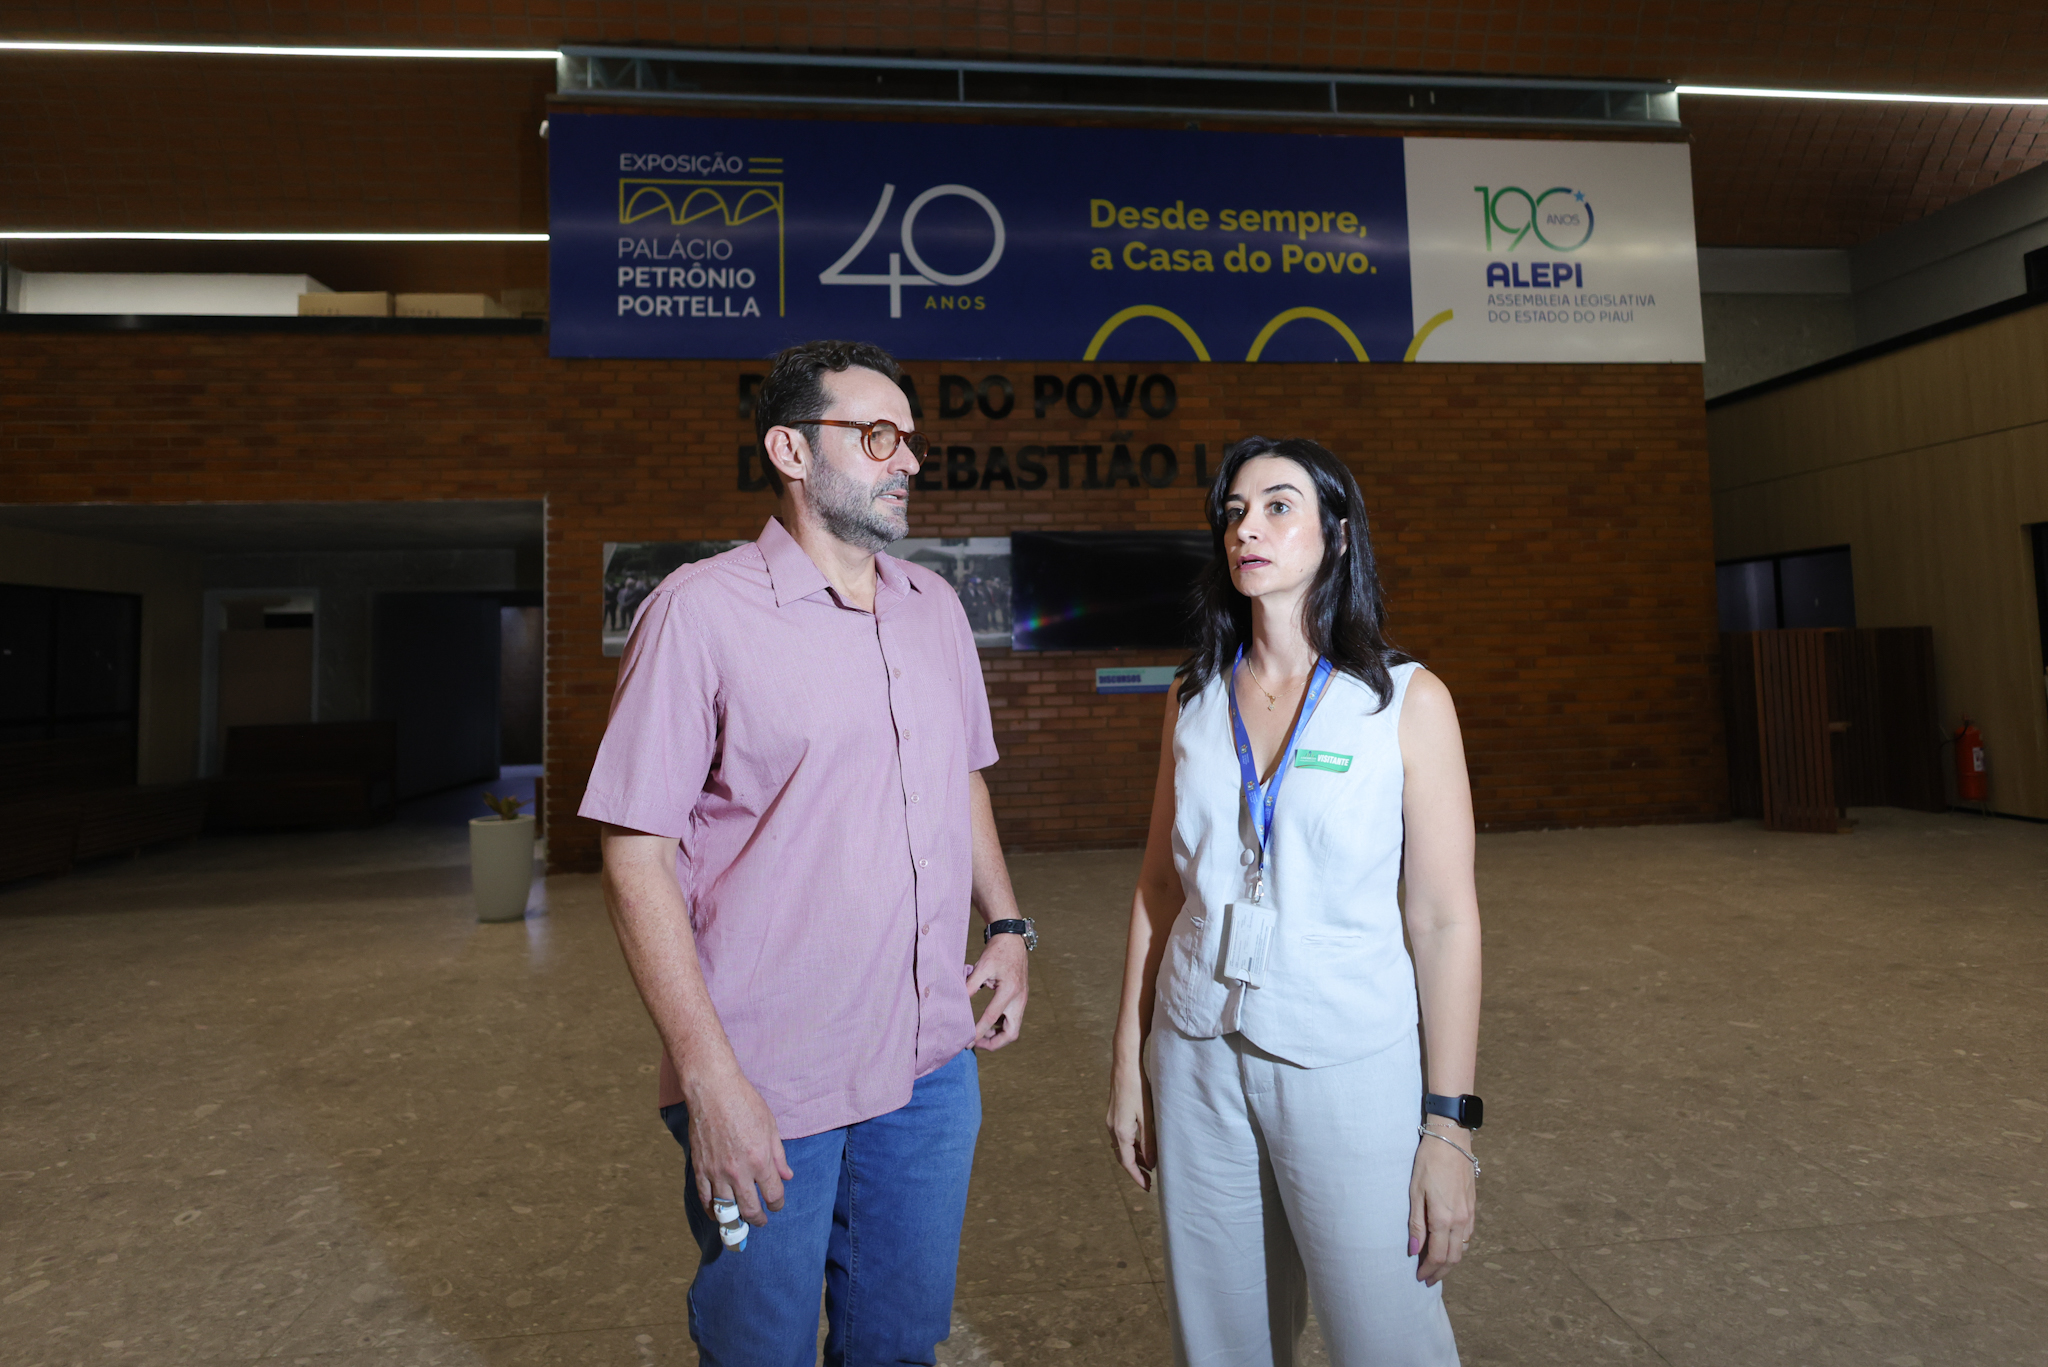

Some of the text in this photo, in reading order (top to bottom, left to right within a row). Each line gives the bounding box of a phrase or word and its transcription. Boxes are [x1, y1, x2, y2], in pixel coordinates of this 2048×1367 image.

[620, 152, 743, 176] EXPOSIÇÃO
[1090, 199, 1367, 241] Desde sempre,
[1474, 186, 1594, 252] 190
[1546, 214, 1580, 226] ANOS
[618, 233, 733, 260] PALÁCIO
[818, 183, 1006, 318] 40
[1090, 241, 1377, 274] a Casa do Povo.
[618, 262, 756, 288] PETRÔNIO
[1486, 262, 1583, 288] ALEPI
[618, 295, 761, 317] PORTELLA
[925, 296, 986, 310] ANOS
[1487, 294, 1656, 307] ASSEMBLEIA LEGISLATIVA
[1488, 310, 1510, 323] DO
[1515, 310, 1569, 323] ESTADO
[1573, 310, 1595, 323] DO
[938, 373, 1015, 420] DO
[1033, 373, 1177, 419] POVO
[911, 430, 1178, 491] EBASTIÃO
[1317, 754, 1350, 766] VISITANTE
